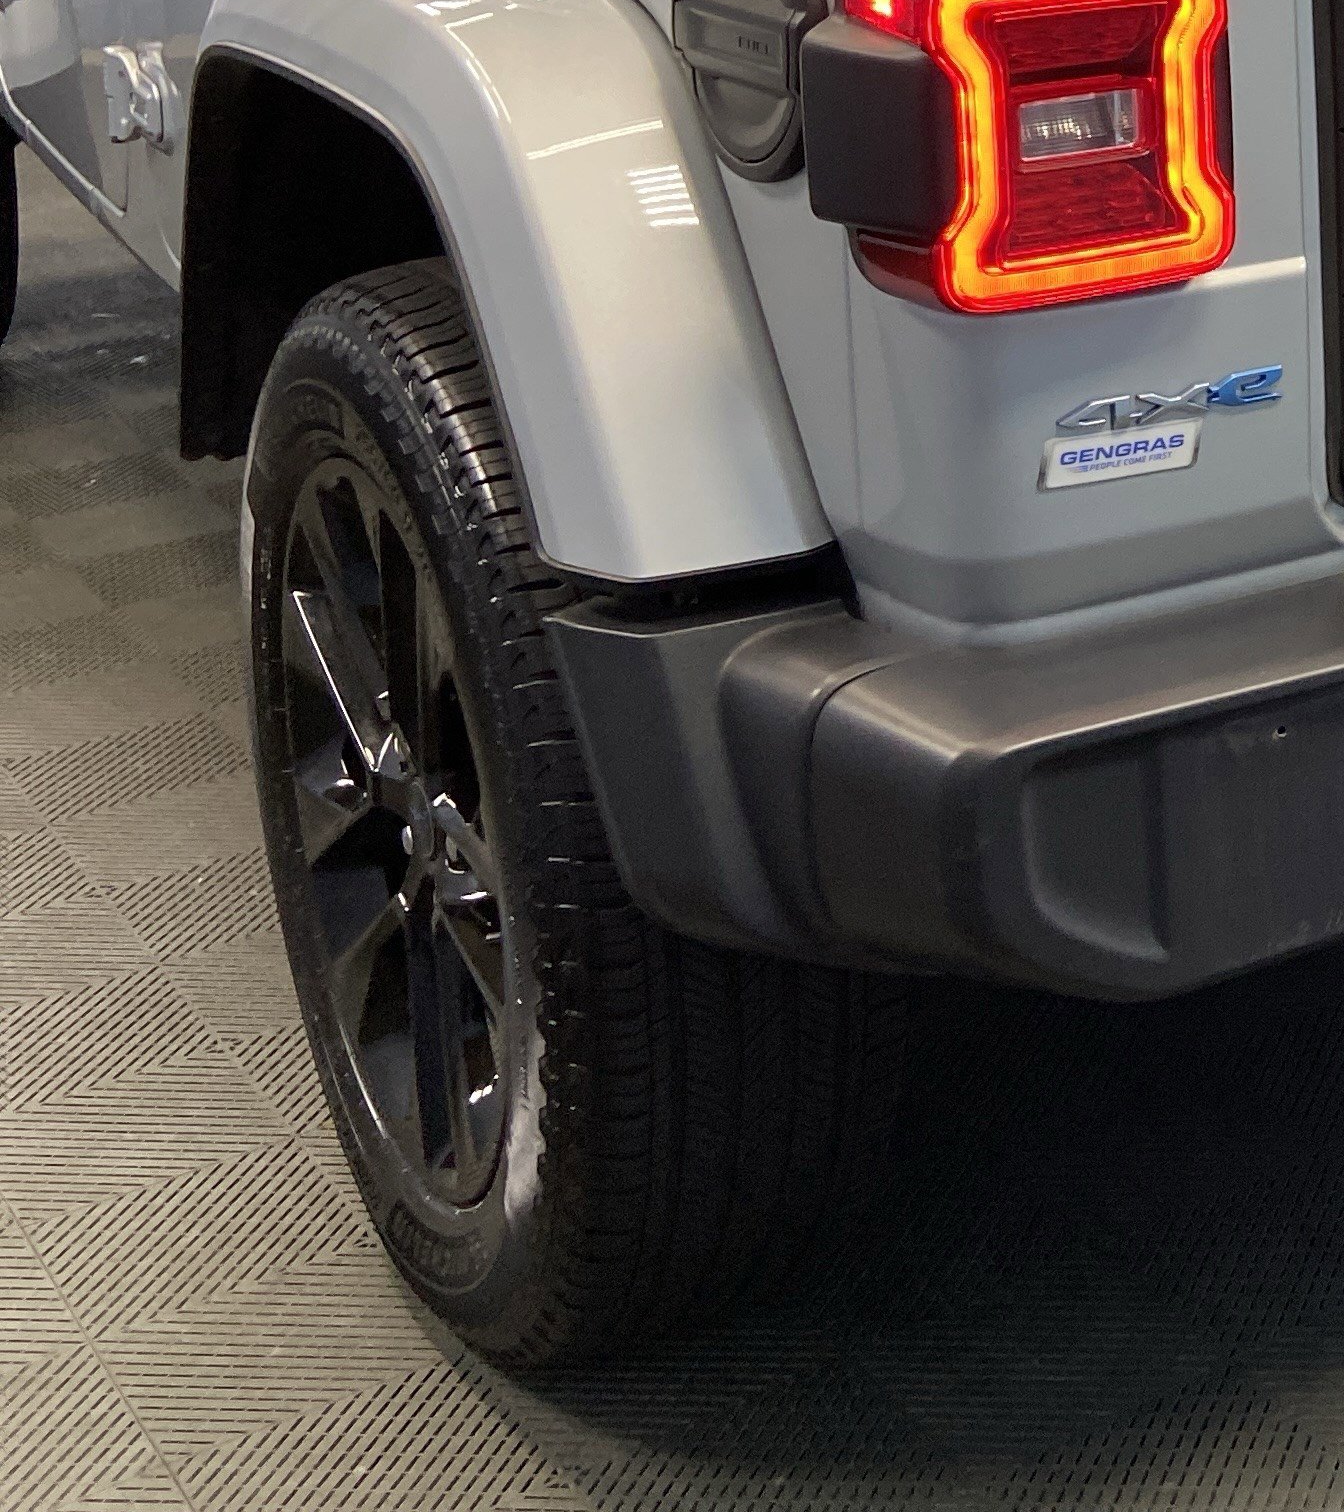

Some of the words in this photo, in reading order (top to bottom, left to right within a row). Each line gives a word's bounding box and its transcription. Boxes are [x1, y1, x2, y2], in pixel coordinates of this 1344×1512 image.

[1060, 434, 1185, 466] GENGRAS
[1090, 460, 1121, 472] PEOPLE
[1123, 455, 1147, 466] COME
[1148, 451, 1173, 462] FIRST
